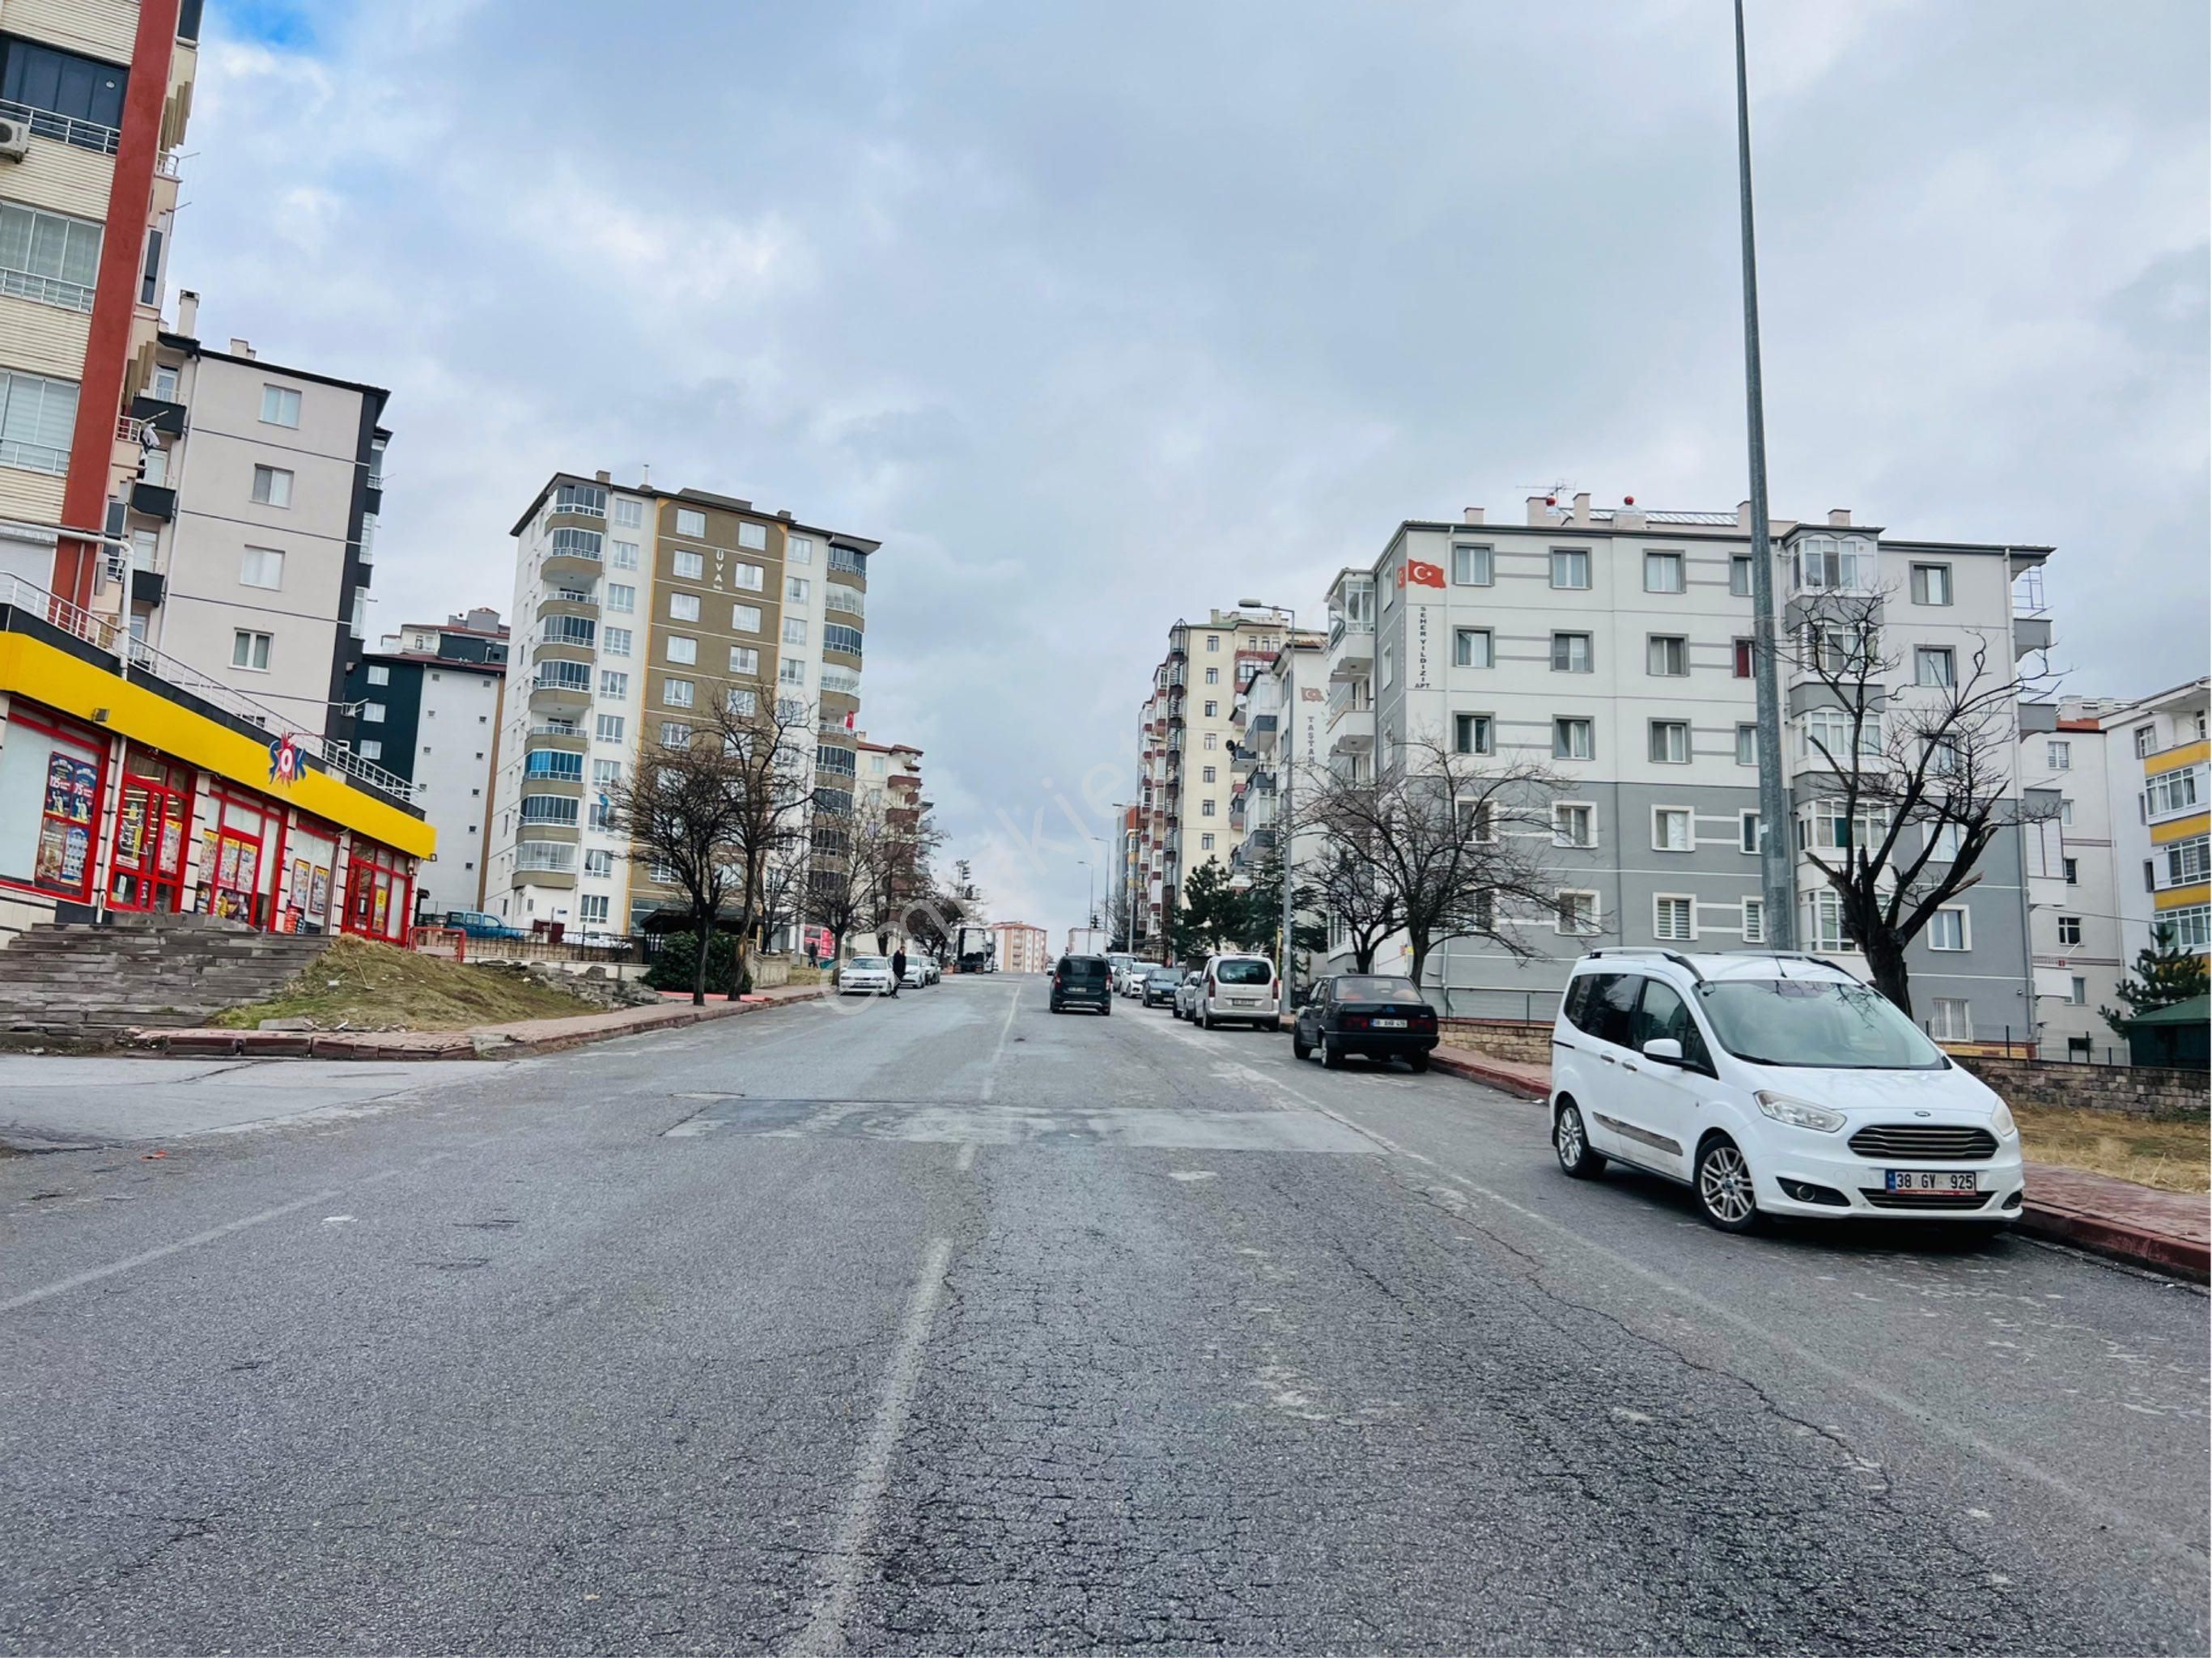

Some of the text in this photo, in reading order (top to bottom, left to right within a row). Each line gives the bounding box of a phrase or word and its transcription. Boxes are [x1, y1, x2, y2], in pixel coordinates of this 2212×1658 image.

[1896, 1173, 1912, 1188] 38
[1921, 1174, 1936, 1189] GV
[1951, 1174, 1973, 1189] 925
